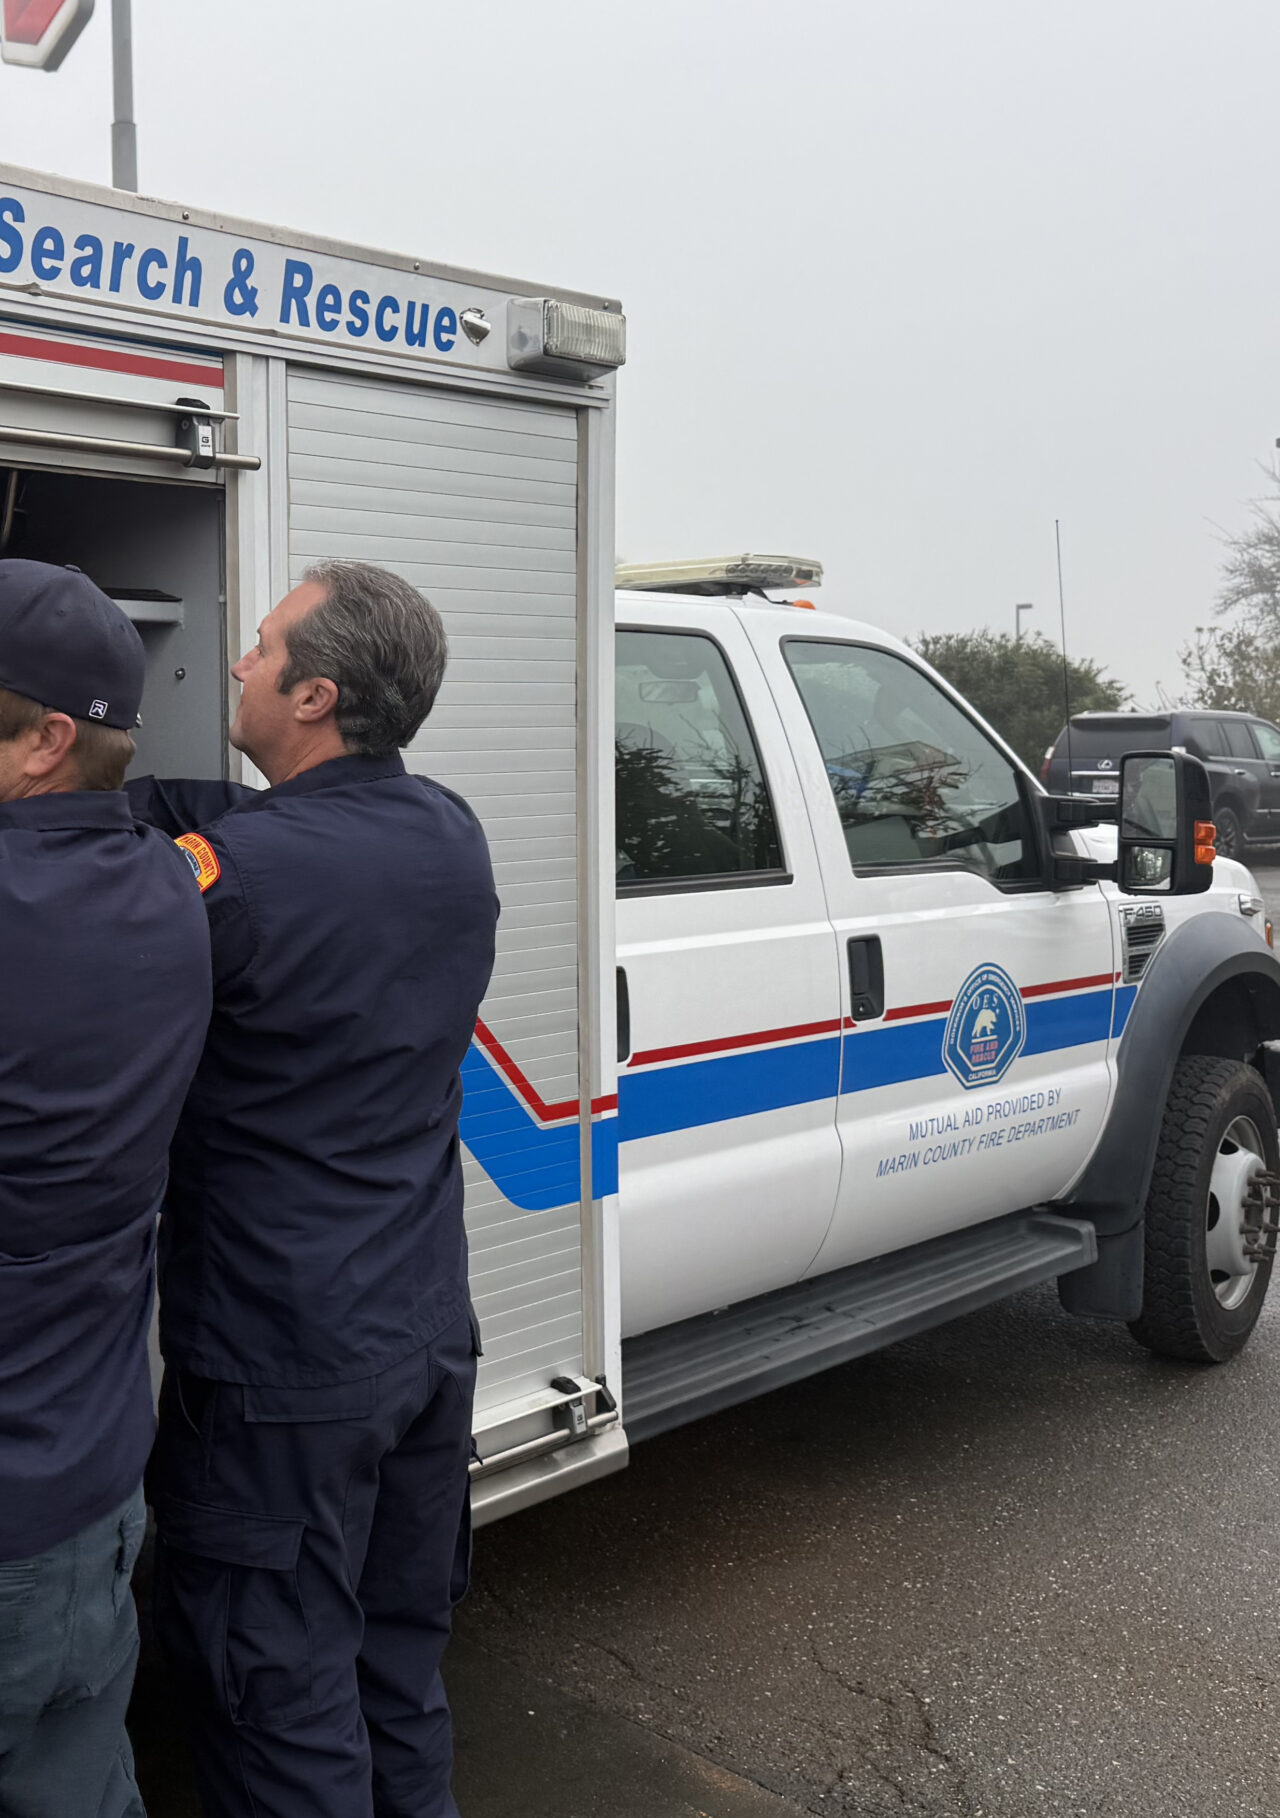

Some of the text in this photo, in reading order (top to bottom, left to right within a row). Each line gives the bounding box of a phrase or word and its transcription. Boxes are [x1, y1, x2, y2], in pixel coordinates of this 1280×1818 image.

[223, 248, 258, 318] &
[280, 258, 457, 352] Rescue
[197, 847, 216, 879] COUNTY
[1123, 905, 1163, 920] F-450
[970, 1041, 998, 1054] FIRE AND
[972, 1051, 996, 1063] RESCUE
[968, 1069, 997, 1080] CALIFORNIA
[909, 1088, 1062, 1141] MUTUAL AID PROVIDED BY
[876, 1109, 1081, 1178] MARIN COUNTY FIRE DEPARTMENT
